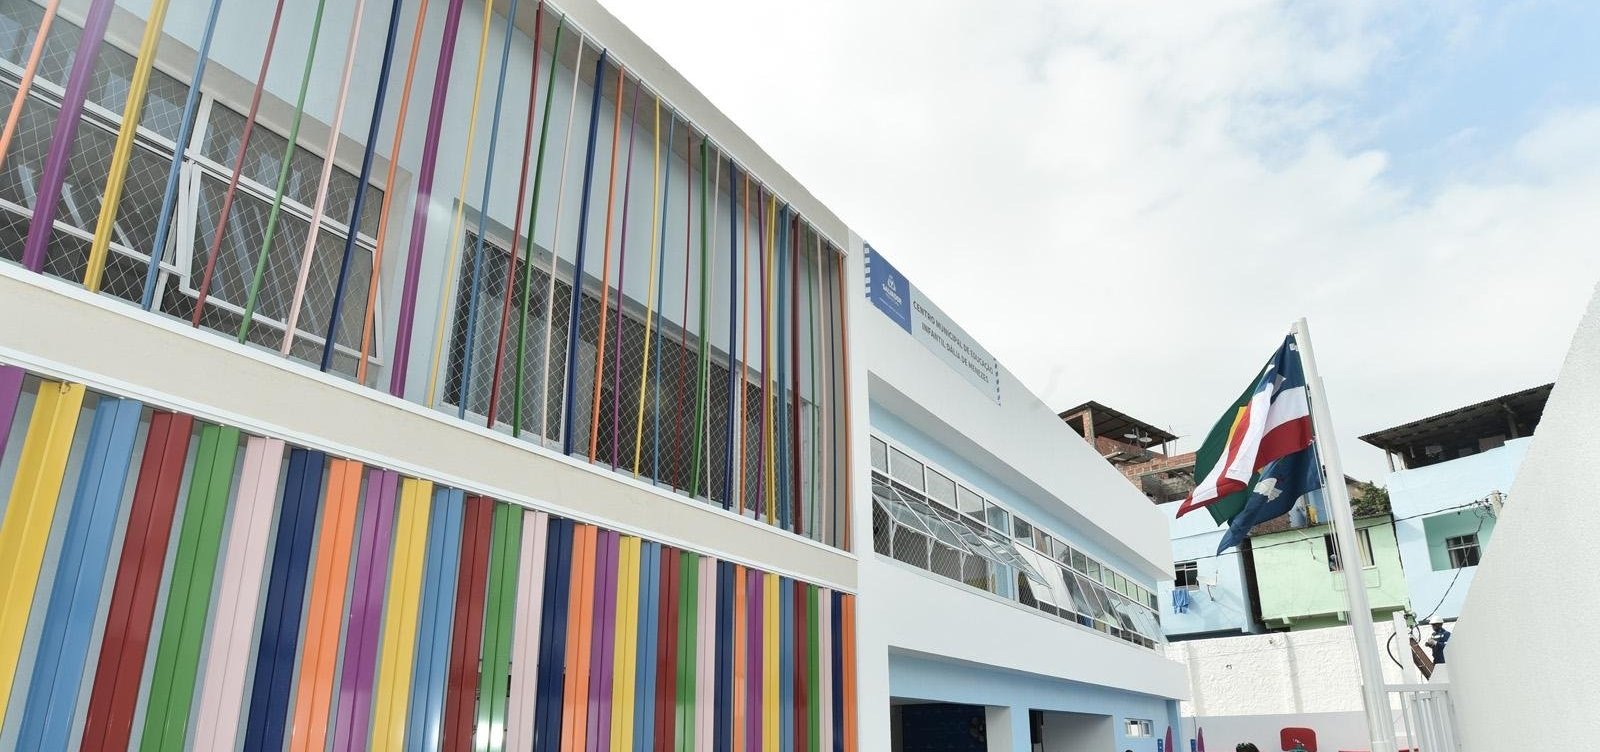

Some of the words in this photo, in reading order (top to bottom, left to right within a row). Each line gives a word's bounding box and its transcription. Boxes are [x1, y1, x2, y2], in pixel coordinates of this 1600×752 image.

[913, 300, 935, 324] CENTRO
[936, 320, 963, 349] MUNICIPAL
[963, 343, 970, 355] DE
[921, 321, 946, 348] INFANTIL
[961, 355, 968, 366] DE
